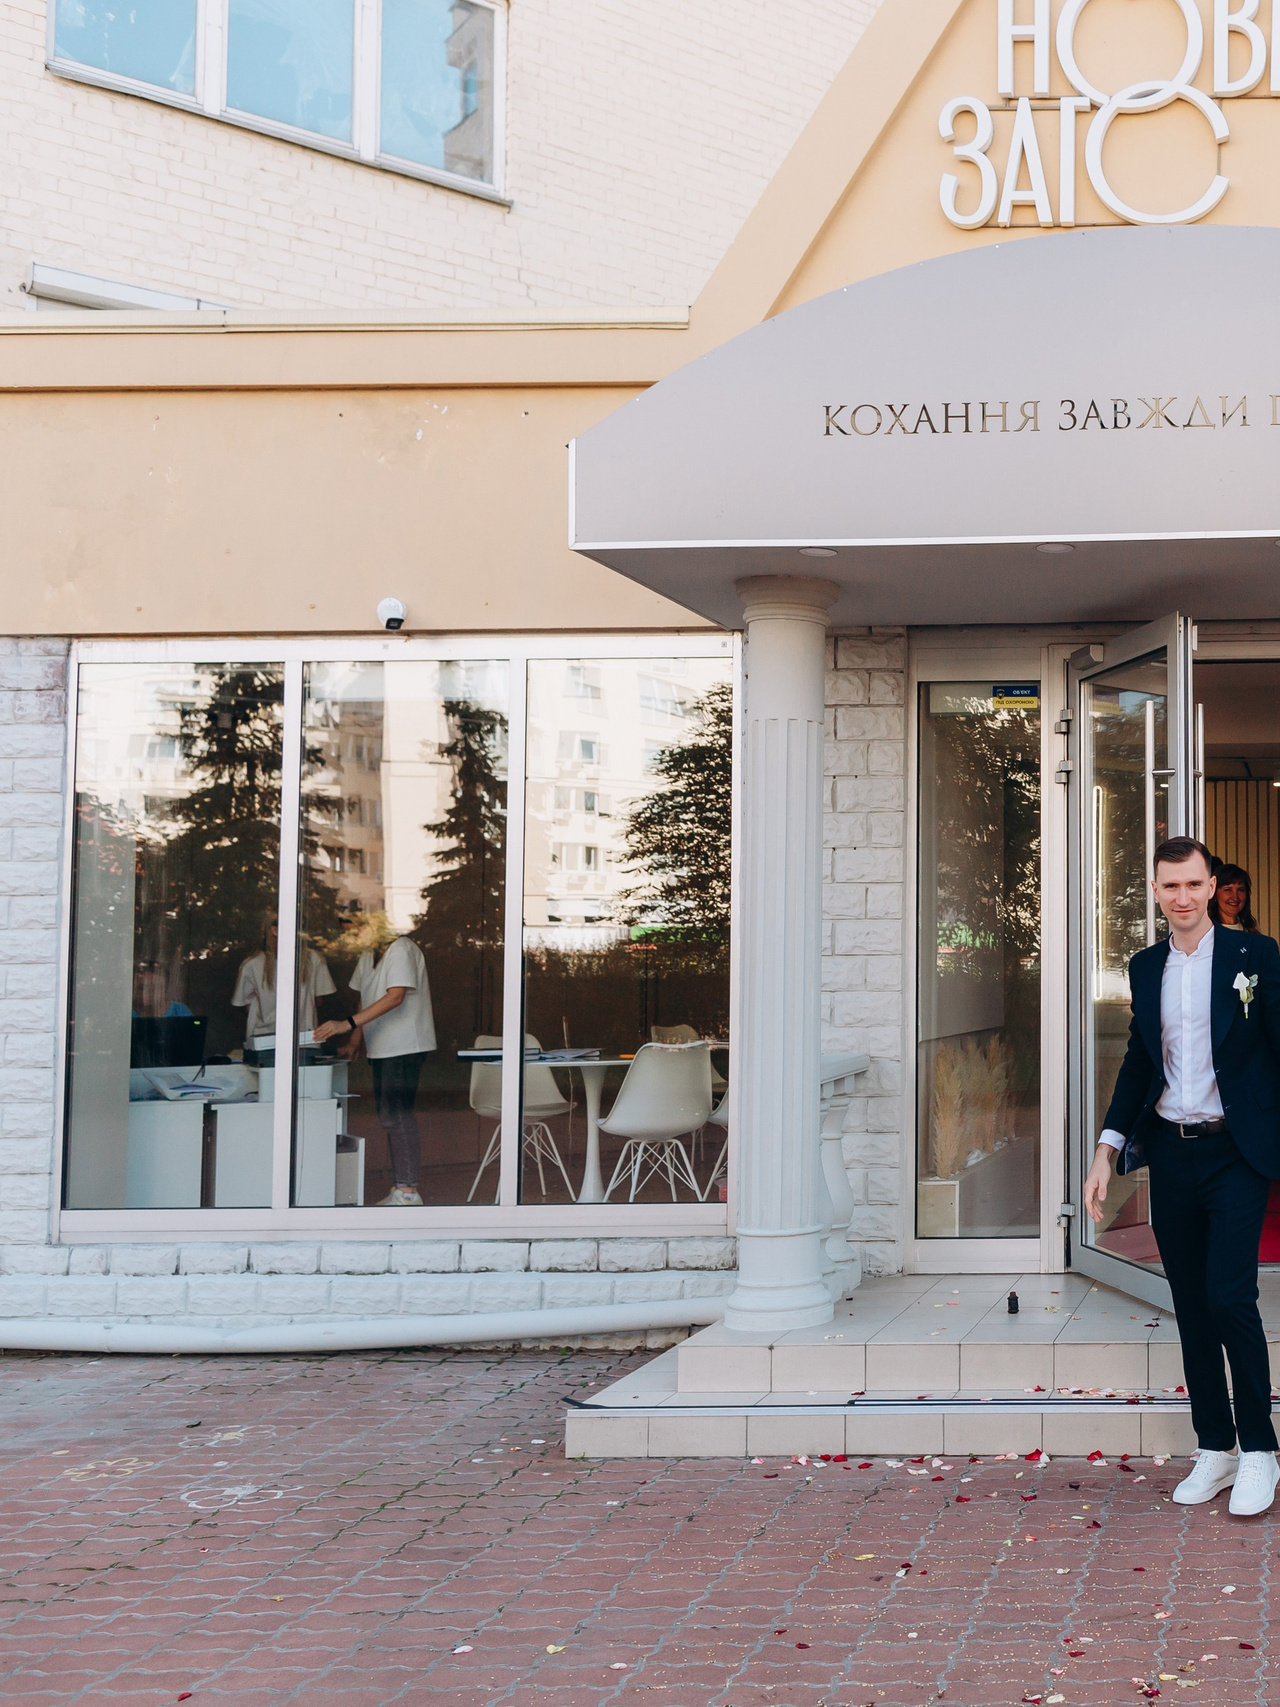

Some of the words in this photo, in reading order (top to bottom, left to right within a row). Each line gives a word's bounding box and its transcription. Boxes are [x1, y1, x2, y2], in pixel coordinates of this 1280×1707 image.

[938, 79, 1230, 229] ЗАГС
[822, 400, 1042, 436] КОХАННЯ
[1058, 394, 1252, 432] ЗАВЖДИ
